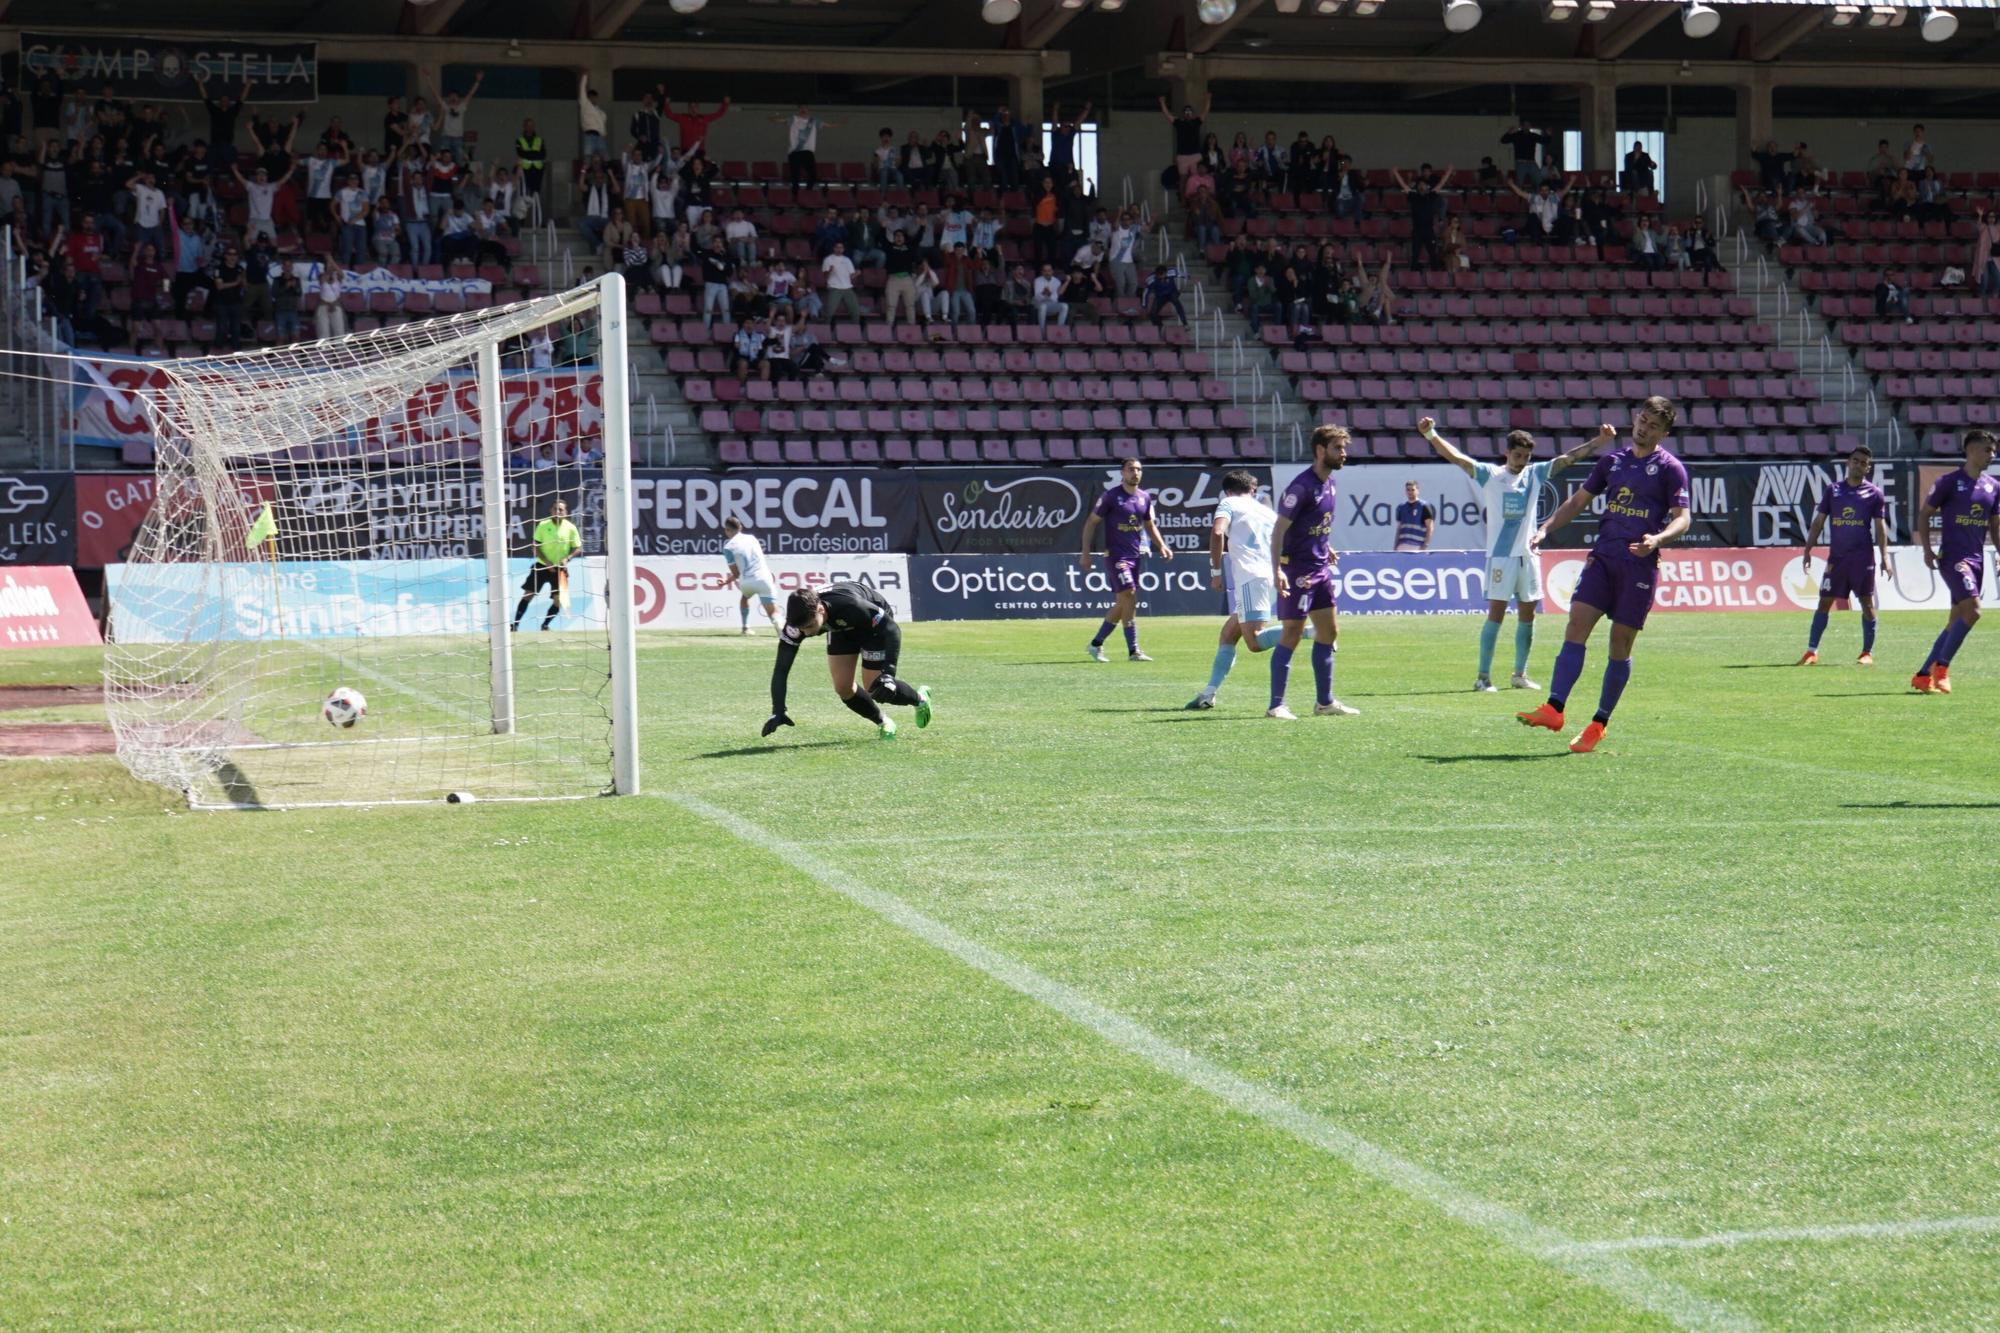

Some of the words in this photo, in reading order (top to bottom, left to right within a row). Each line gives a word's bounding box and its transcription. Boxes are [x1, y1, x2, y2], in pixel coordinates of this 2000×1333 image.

[631, 477, 888, 529] FERRECAL
[937, 477, 1081, 532] Sendeiro
[371, 515, 526, 540] HYUPERA
[778, 532, 889, 553] Profesional
[1163, 535, 1200, 550] PUB
[931, 560, 1056, 599] Óptica
[1711, 561, 1753, 583] DO
[1041, 598, 1082, 609] ÓPTICO
[1655, 585, 1778, 609] CADILLO
[680, 601, 732, 619] Taller
